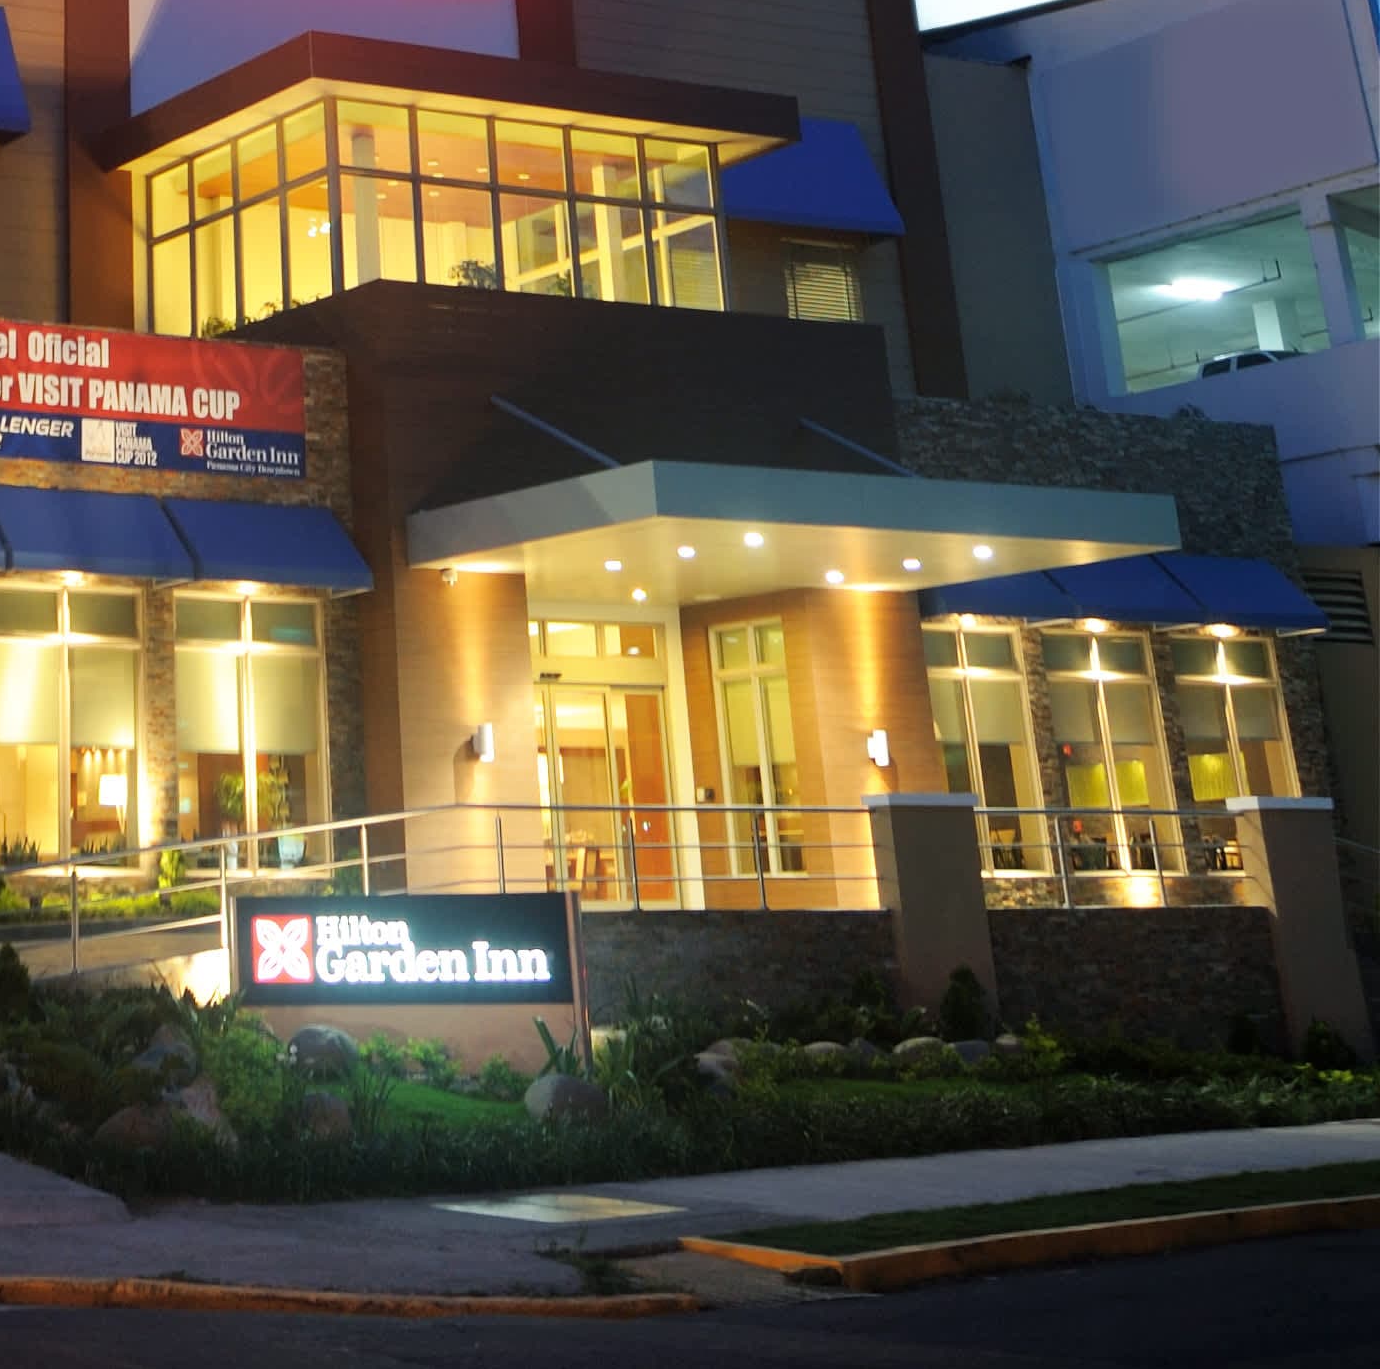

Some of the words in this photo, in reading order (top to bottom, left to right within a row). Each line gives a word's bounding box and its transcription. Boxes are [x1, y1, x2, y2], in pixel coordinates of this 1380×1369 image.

[28, 331, 109, 368] Oficial
[18, 372, 83, 408] VISIT
[88, 379, 188, 418] PANAMA
[192, 388, 240, 420] CUP
[115, 421, 138, 437] VISIT
[207, 429, 245, 445] Hilton
[115, 450, 133, 464] CUP
[134, 451, 157, 466] 2012
[205, 442, 267, 462] Garden
[270, 446, 300, 465] Inn
[315, 915, 410, 947] Hilton
[315, 940, 470, 982] Garden
[472, 940, 550, 982] Inn
